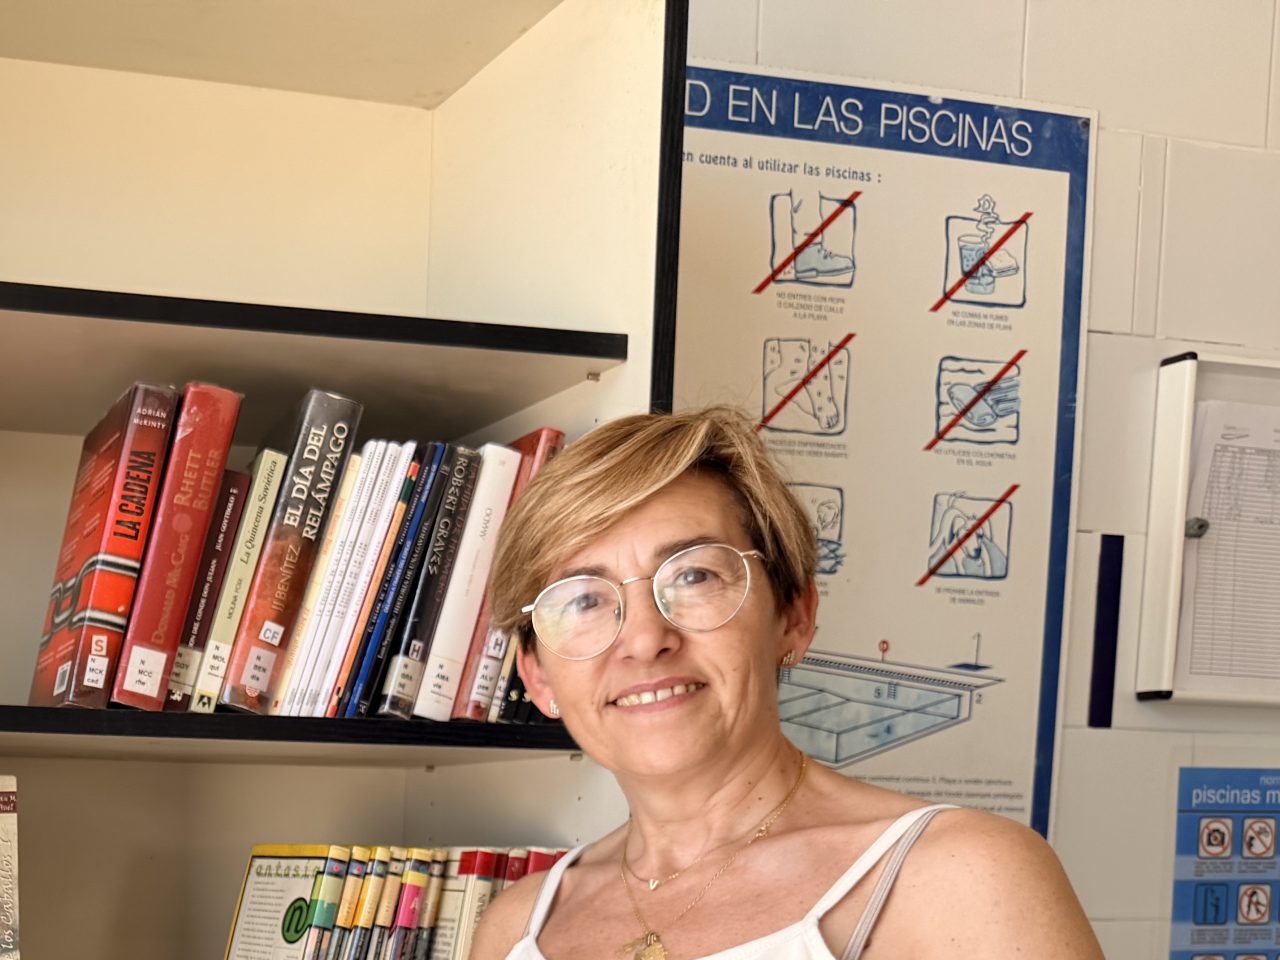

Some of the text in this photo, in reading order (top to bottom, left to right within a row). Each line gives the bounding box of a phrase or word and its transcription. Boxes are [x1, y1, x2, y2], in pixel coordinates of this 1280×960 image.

[728, 85, 777, 125] EN
[794, 93, 863, 135] LAS
[880, 103, 1033, 157] PISCINAS
[699, 153, 737, 167] cuenta
[743, 158, 752, 169] al
[758, 160, 798, 174] utilizar
[804, 163, 820, 176] las
[825, 167, 871, 182] piscinas
[113, 451, 156, 540] LA CADENA
[174, 449, 201, 505] RHETT
[193, 450, 220, 510] BUTLER
[283, 424, 327, 528] EL DÍA DEL
[302, 421, 348, 542] RELÁMPAGO
[445, 456, 470, 514] ROBERT
[239, 550, 251, 564] La
[245, 504, 265, 551] Quincena
[258, 460, 278, 506] Soviética
[274, 543, 300, 600] BENÍTEZ
[428, 517, 451, 576] GRAVES
[94, 640, 103, 652] S
[263, 628, 280, 641] CF
[411, 644, 420, 657] H
[492, 639, 503, 651] H
[89, 667, 104, 675] MCK
[138, 670, 152, 678] MCC
[1192, 784, 1260, 807] piscinas
[0, 854, 13, 924] Caballos
[1, 928, 13, 948] los
